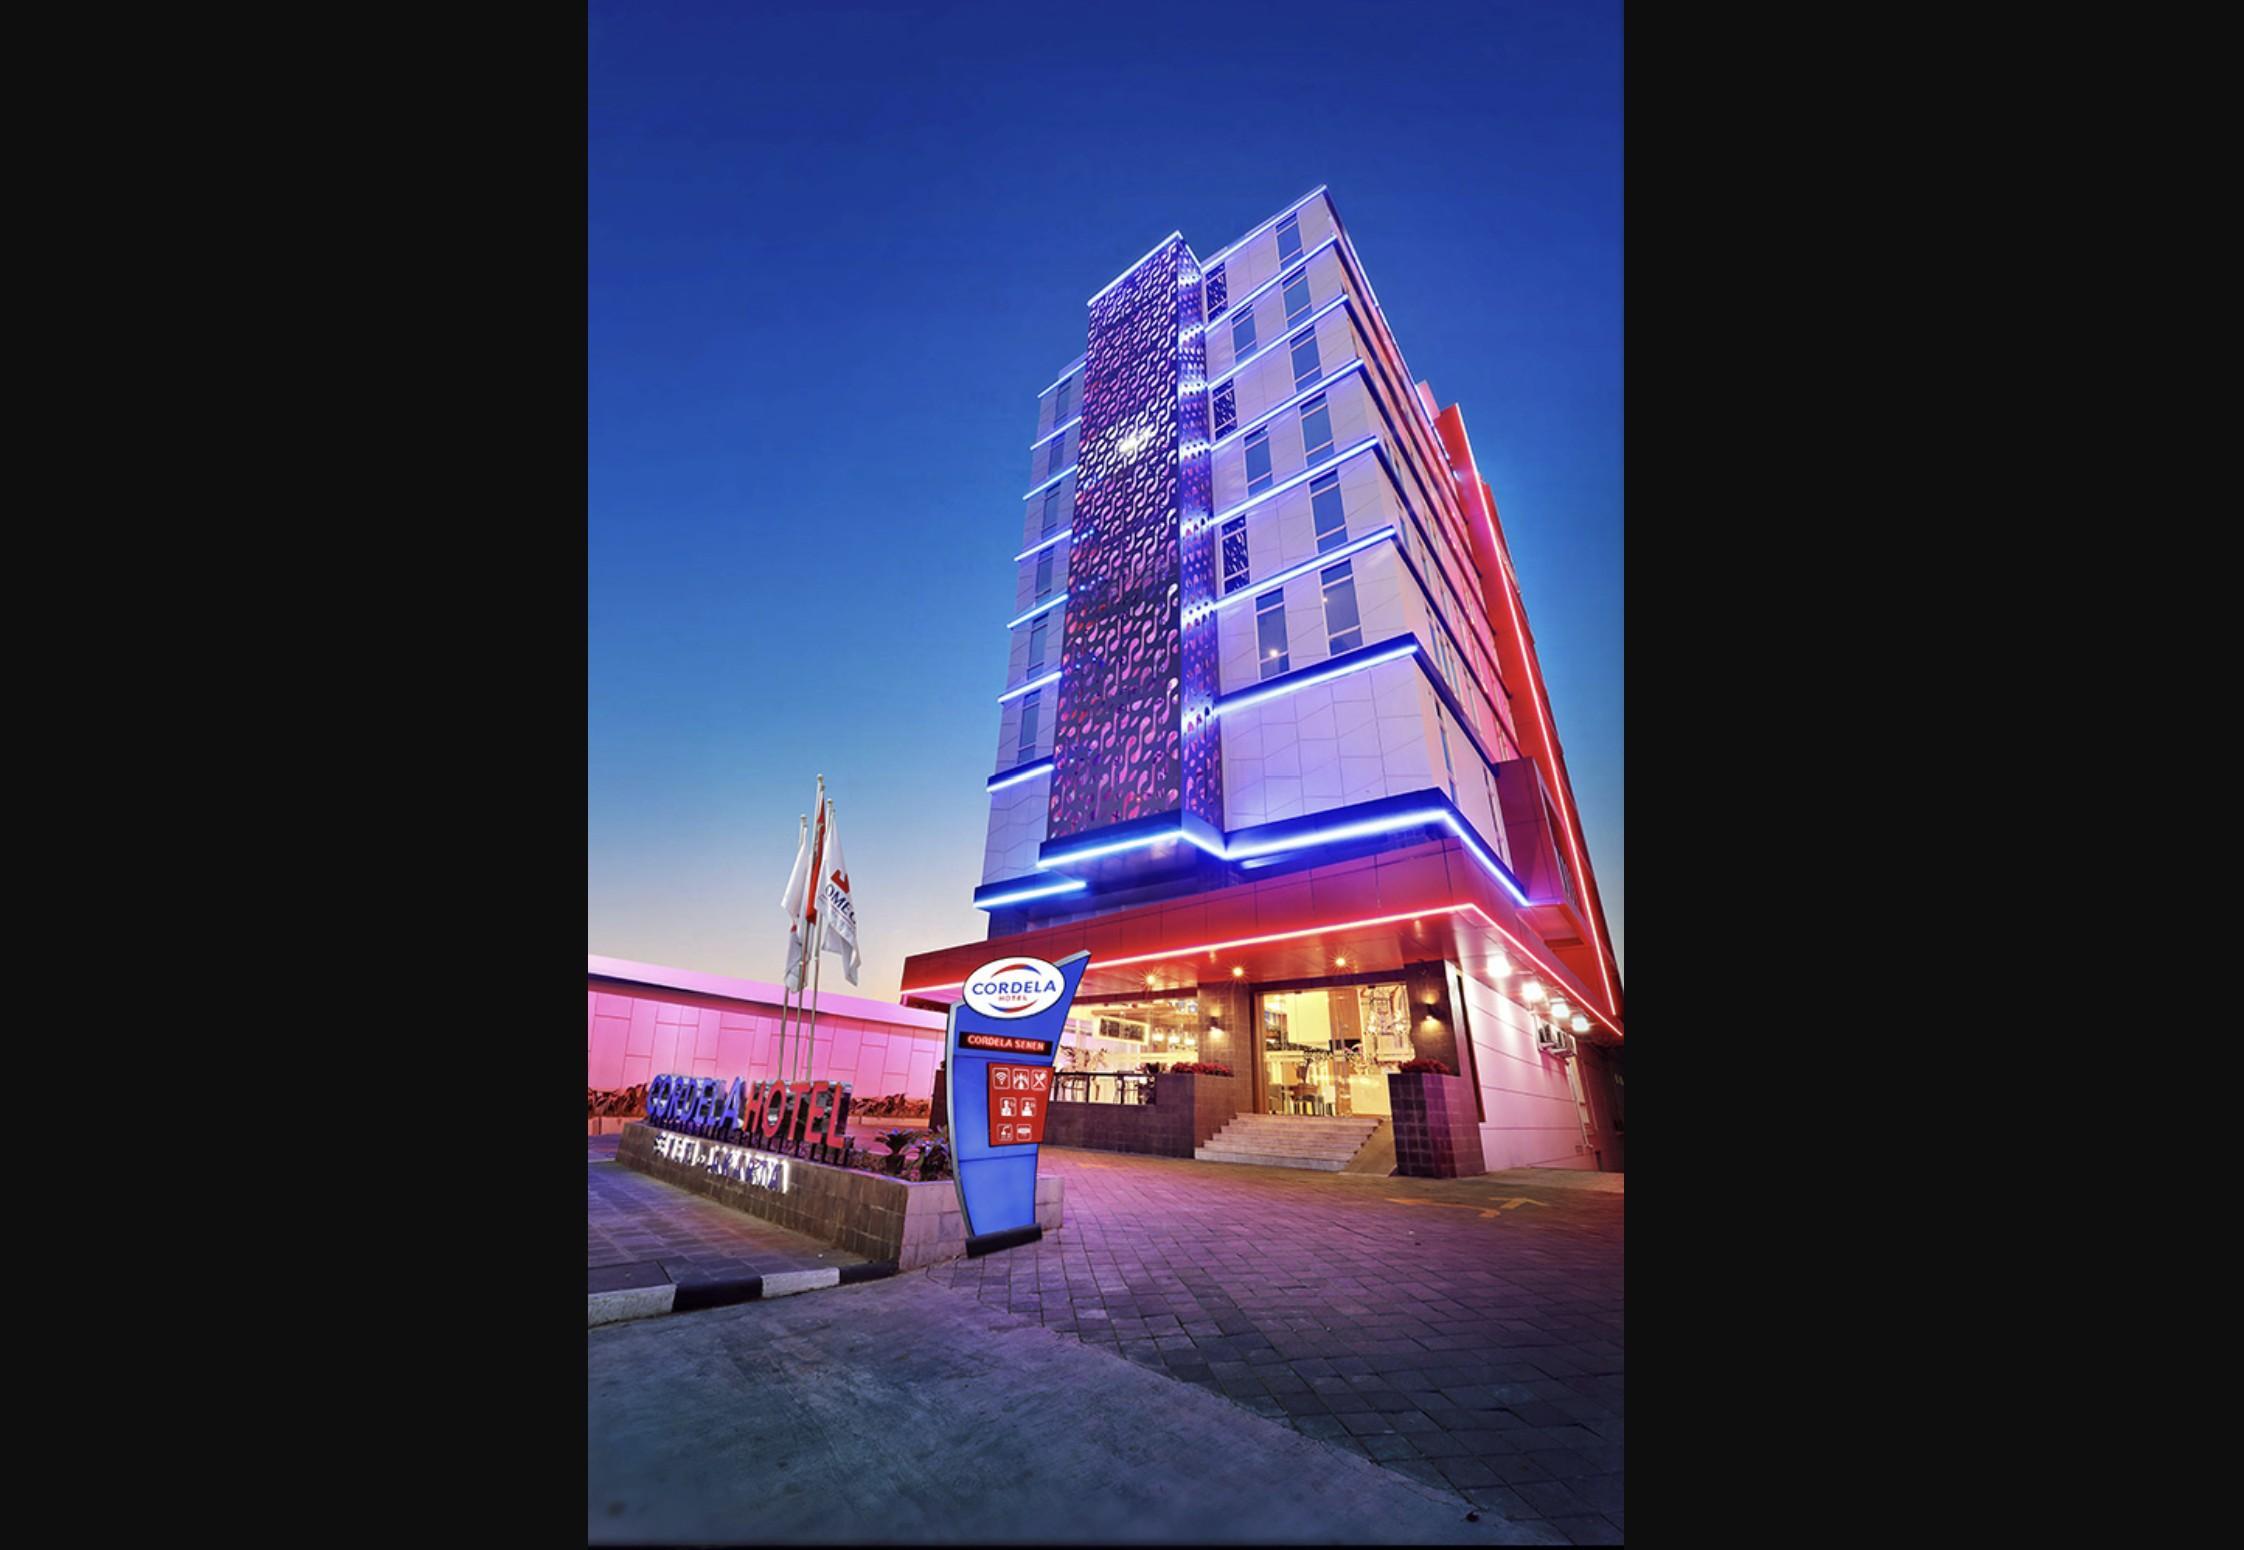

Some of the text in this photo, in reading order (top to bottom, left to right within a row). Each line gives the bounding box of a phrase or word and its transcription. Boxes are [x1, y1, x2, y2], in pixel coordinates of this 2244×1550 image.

[972, 980, 1056, 995] CORDELA
[967, 1034, 1045, 1052] CORDELA SENEN
[646, 1074, 849, 1148] CORDELA HOTEL
